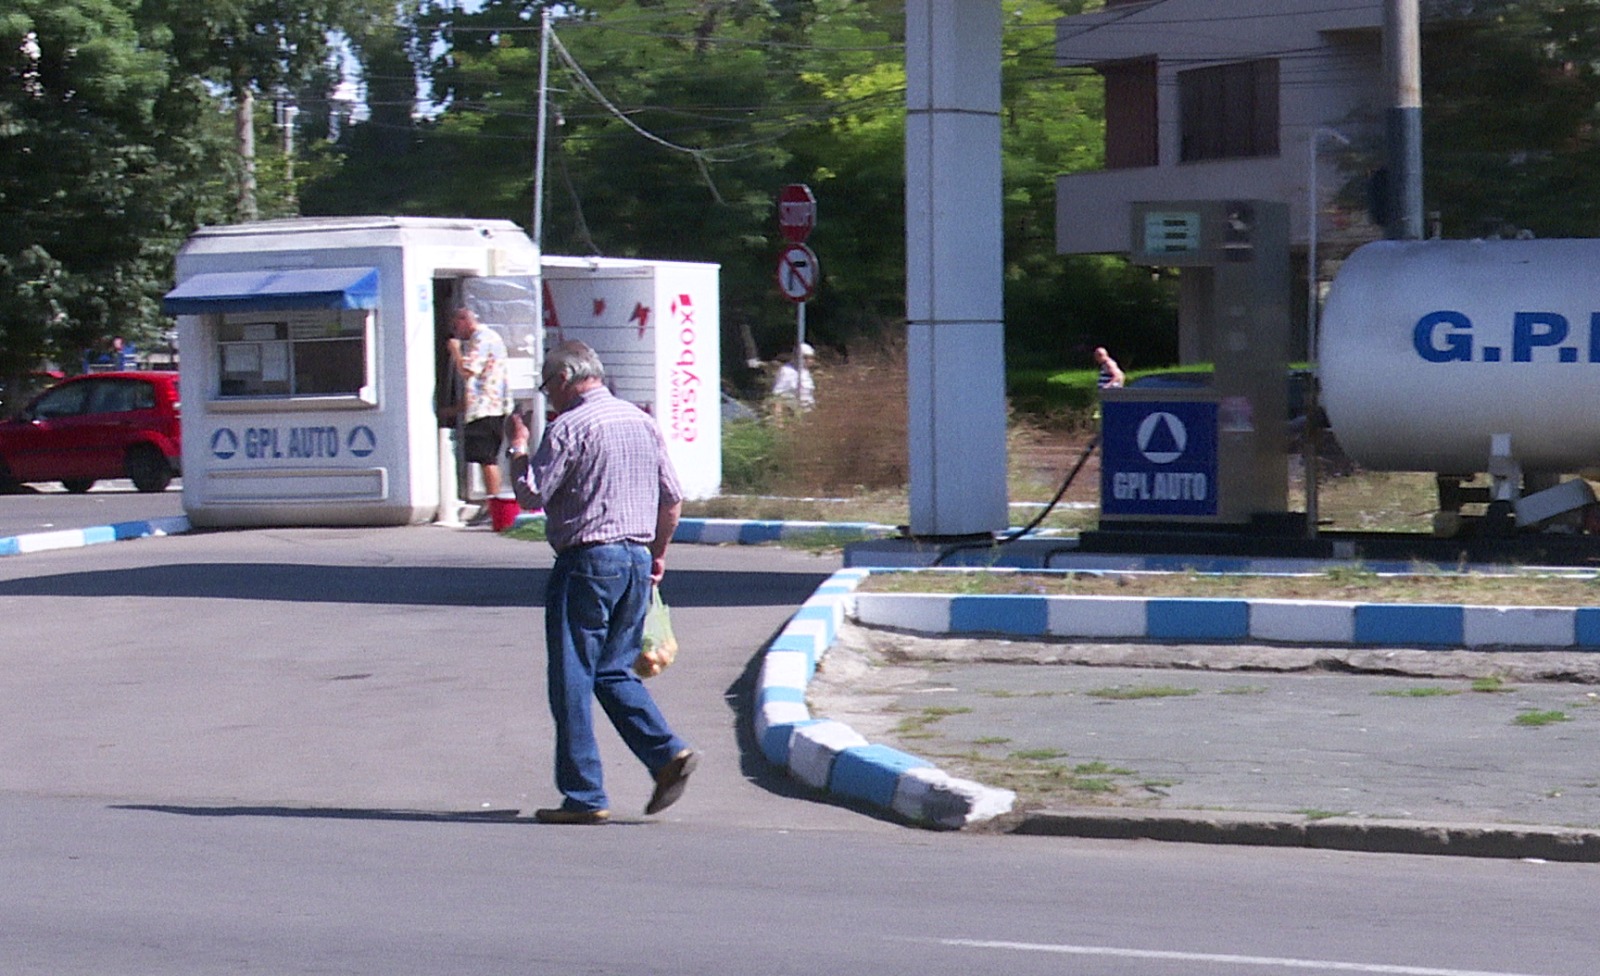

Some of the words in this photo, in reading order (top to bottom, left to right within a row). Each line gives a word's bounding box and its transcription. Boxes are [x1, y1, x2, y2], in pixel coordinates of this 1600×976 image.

[676, 310, 700, 443] easybox
[245, 427, 283, 459] GPL
[289, 426, 339, 458] AUTO
[1112, 471, 1151, 500] GPL
[1153, 471, 1207, 500] AUTO
